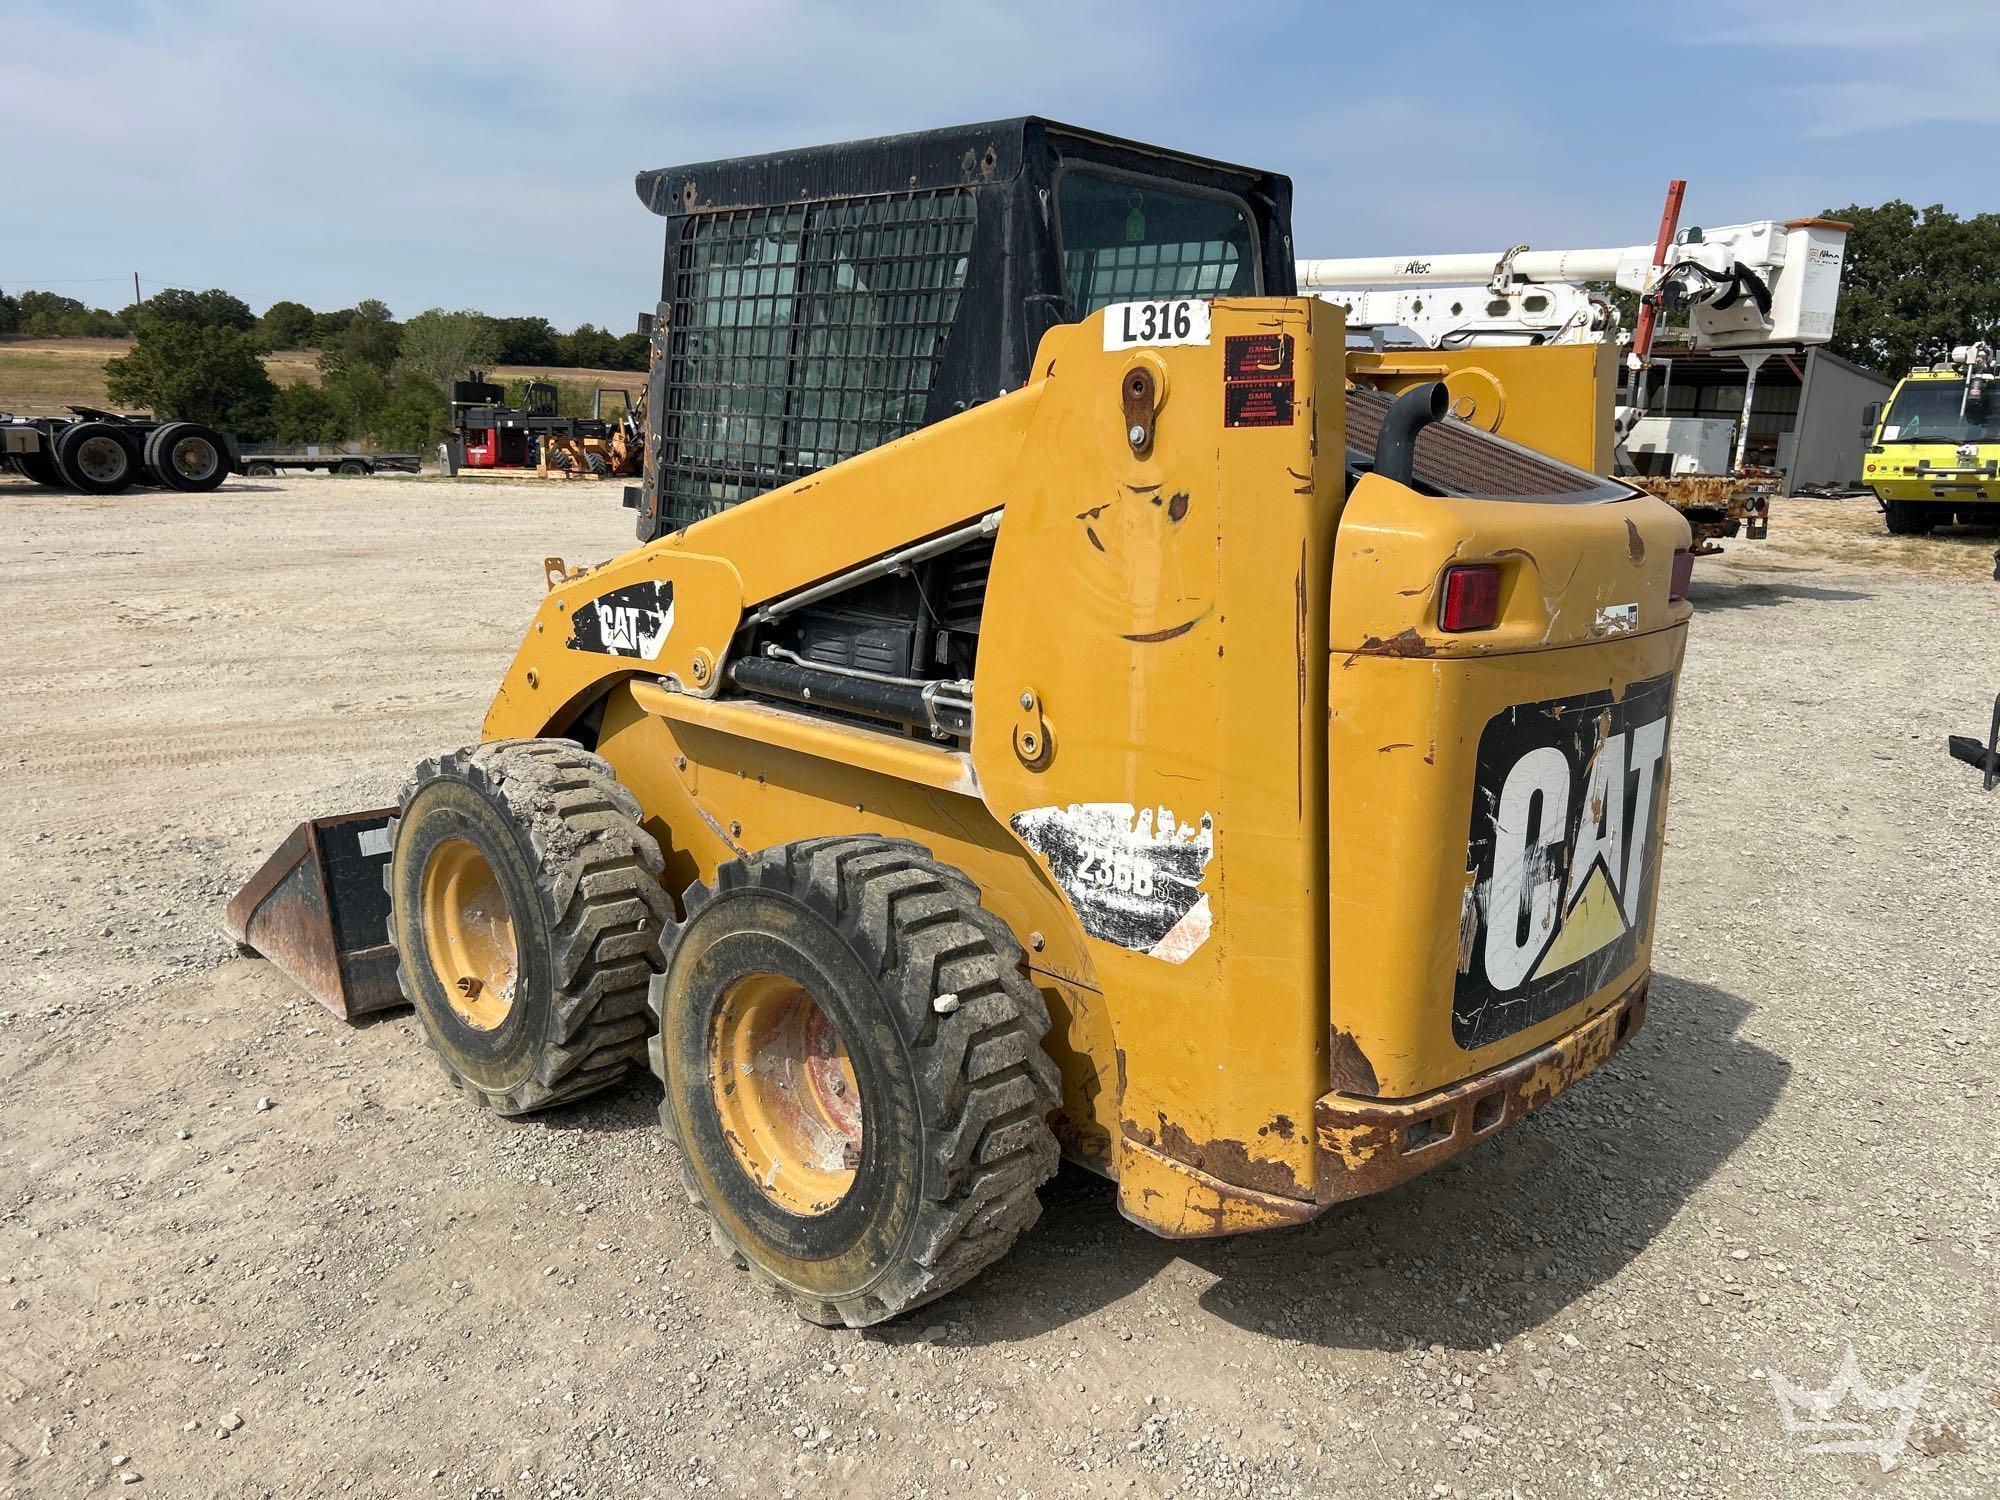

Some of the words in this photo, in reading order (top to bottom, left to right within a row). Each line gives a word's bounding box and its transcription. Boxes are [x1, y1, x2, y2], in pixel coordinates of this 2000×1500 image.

[1405, 260, 1431, 274] Altec
[1123, 302, 1191, 342] L316
[1248, 392, 1272, 400] SMM
[600, 604, 639, 650] CAT
[1484, 716, 1667, 991] CAT
